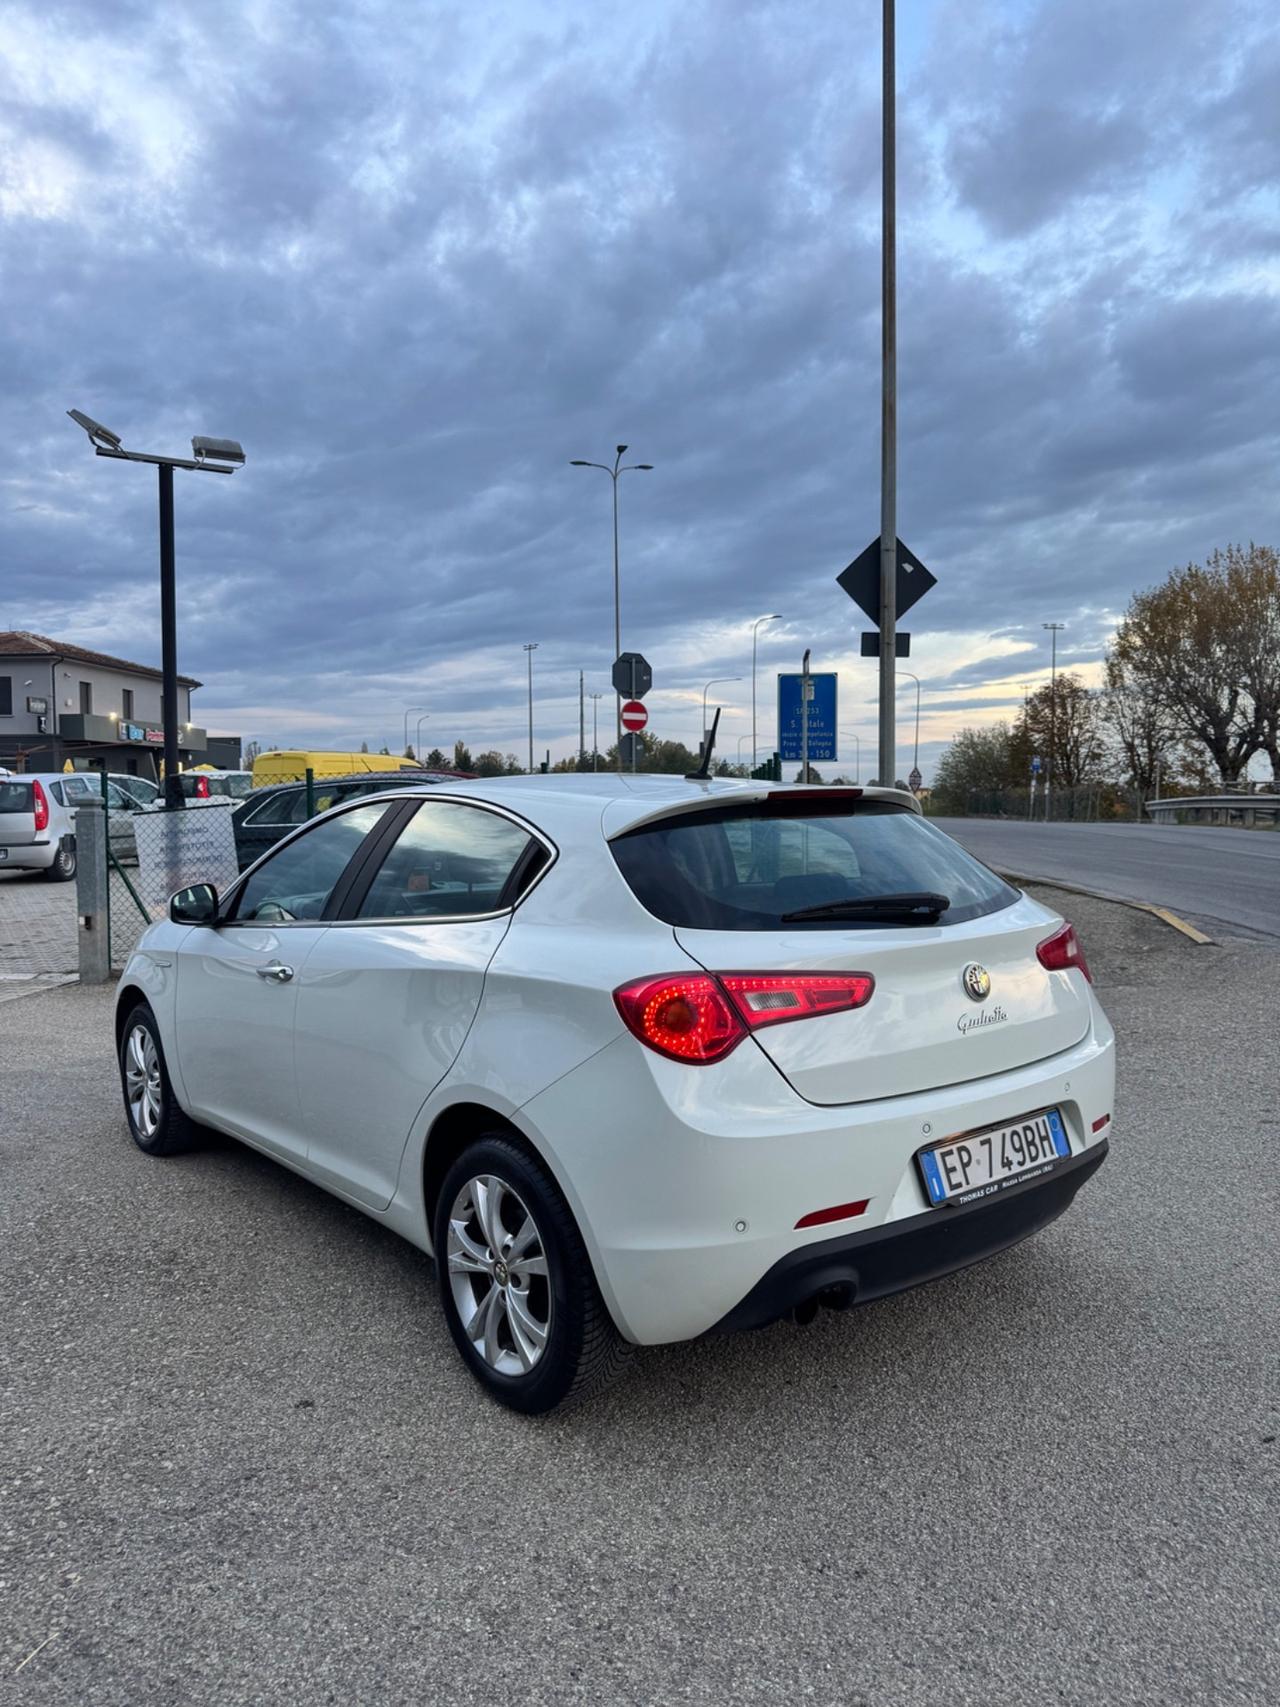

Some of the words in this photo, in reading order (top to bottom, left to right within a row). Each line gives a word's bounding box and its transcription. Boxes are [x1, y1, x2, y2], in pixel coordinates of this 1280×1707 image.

[957, 1006, 1008, 1035] Giulietta
[960, 1190, 985, 1205] THOMAS
[985, 1184, 999, 1195] CAR
